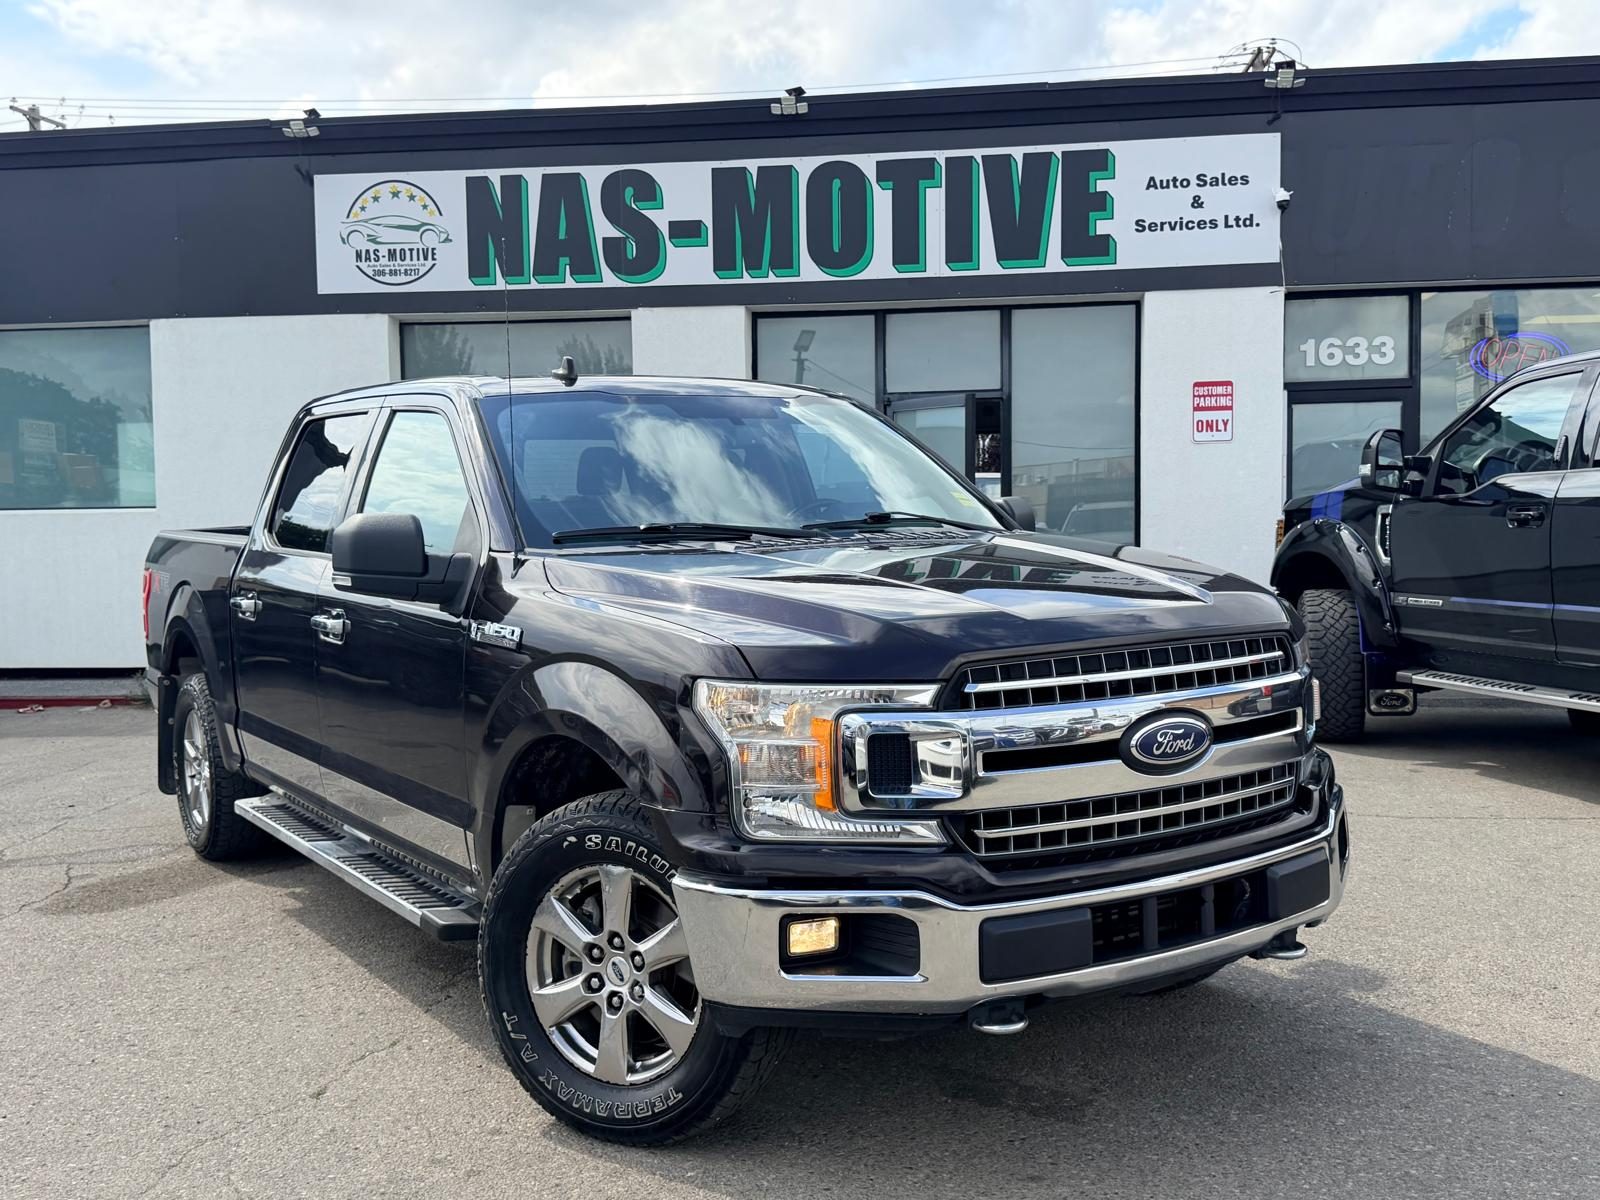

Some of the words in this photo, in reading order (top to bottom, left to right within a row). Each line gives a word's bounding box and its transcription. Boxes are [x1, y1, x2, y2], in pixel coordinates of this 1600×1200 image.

[1145, 175, 1191, 191] Auto
[1195, 172, 1250, 188] Sales
[1190, 194, 1205, 210] &
[465, 148, 1117, 285] NAS-MOTIVE
[1134, 216, 1219, 233] Services
[1223, 213, 1261, 230] Ltd.
[355, 247, 437, 263] NAS-MOTIVE
[372, 268, 420, 277] 306-881-8217
[1299, 336, 1396, 367] 1633
[1194, 385, 1233, 396] CUSTOMER
[1194, 396, 1233, 408] PARKING
[1196, 418, 1230, 433] ONLY
[471, 621, 522, 642] F-150
[1152, 728, 1196, 755] Ford
[539, 1067, 684, 1119] TERRAMAX
